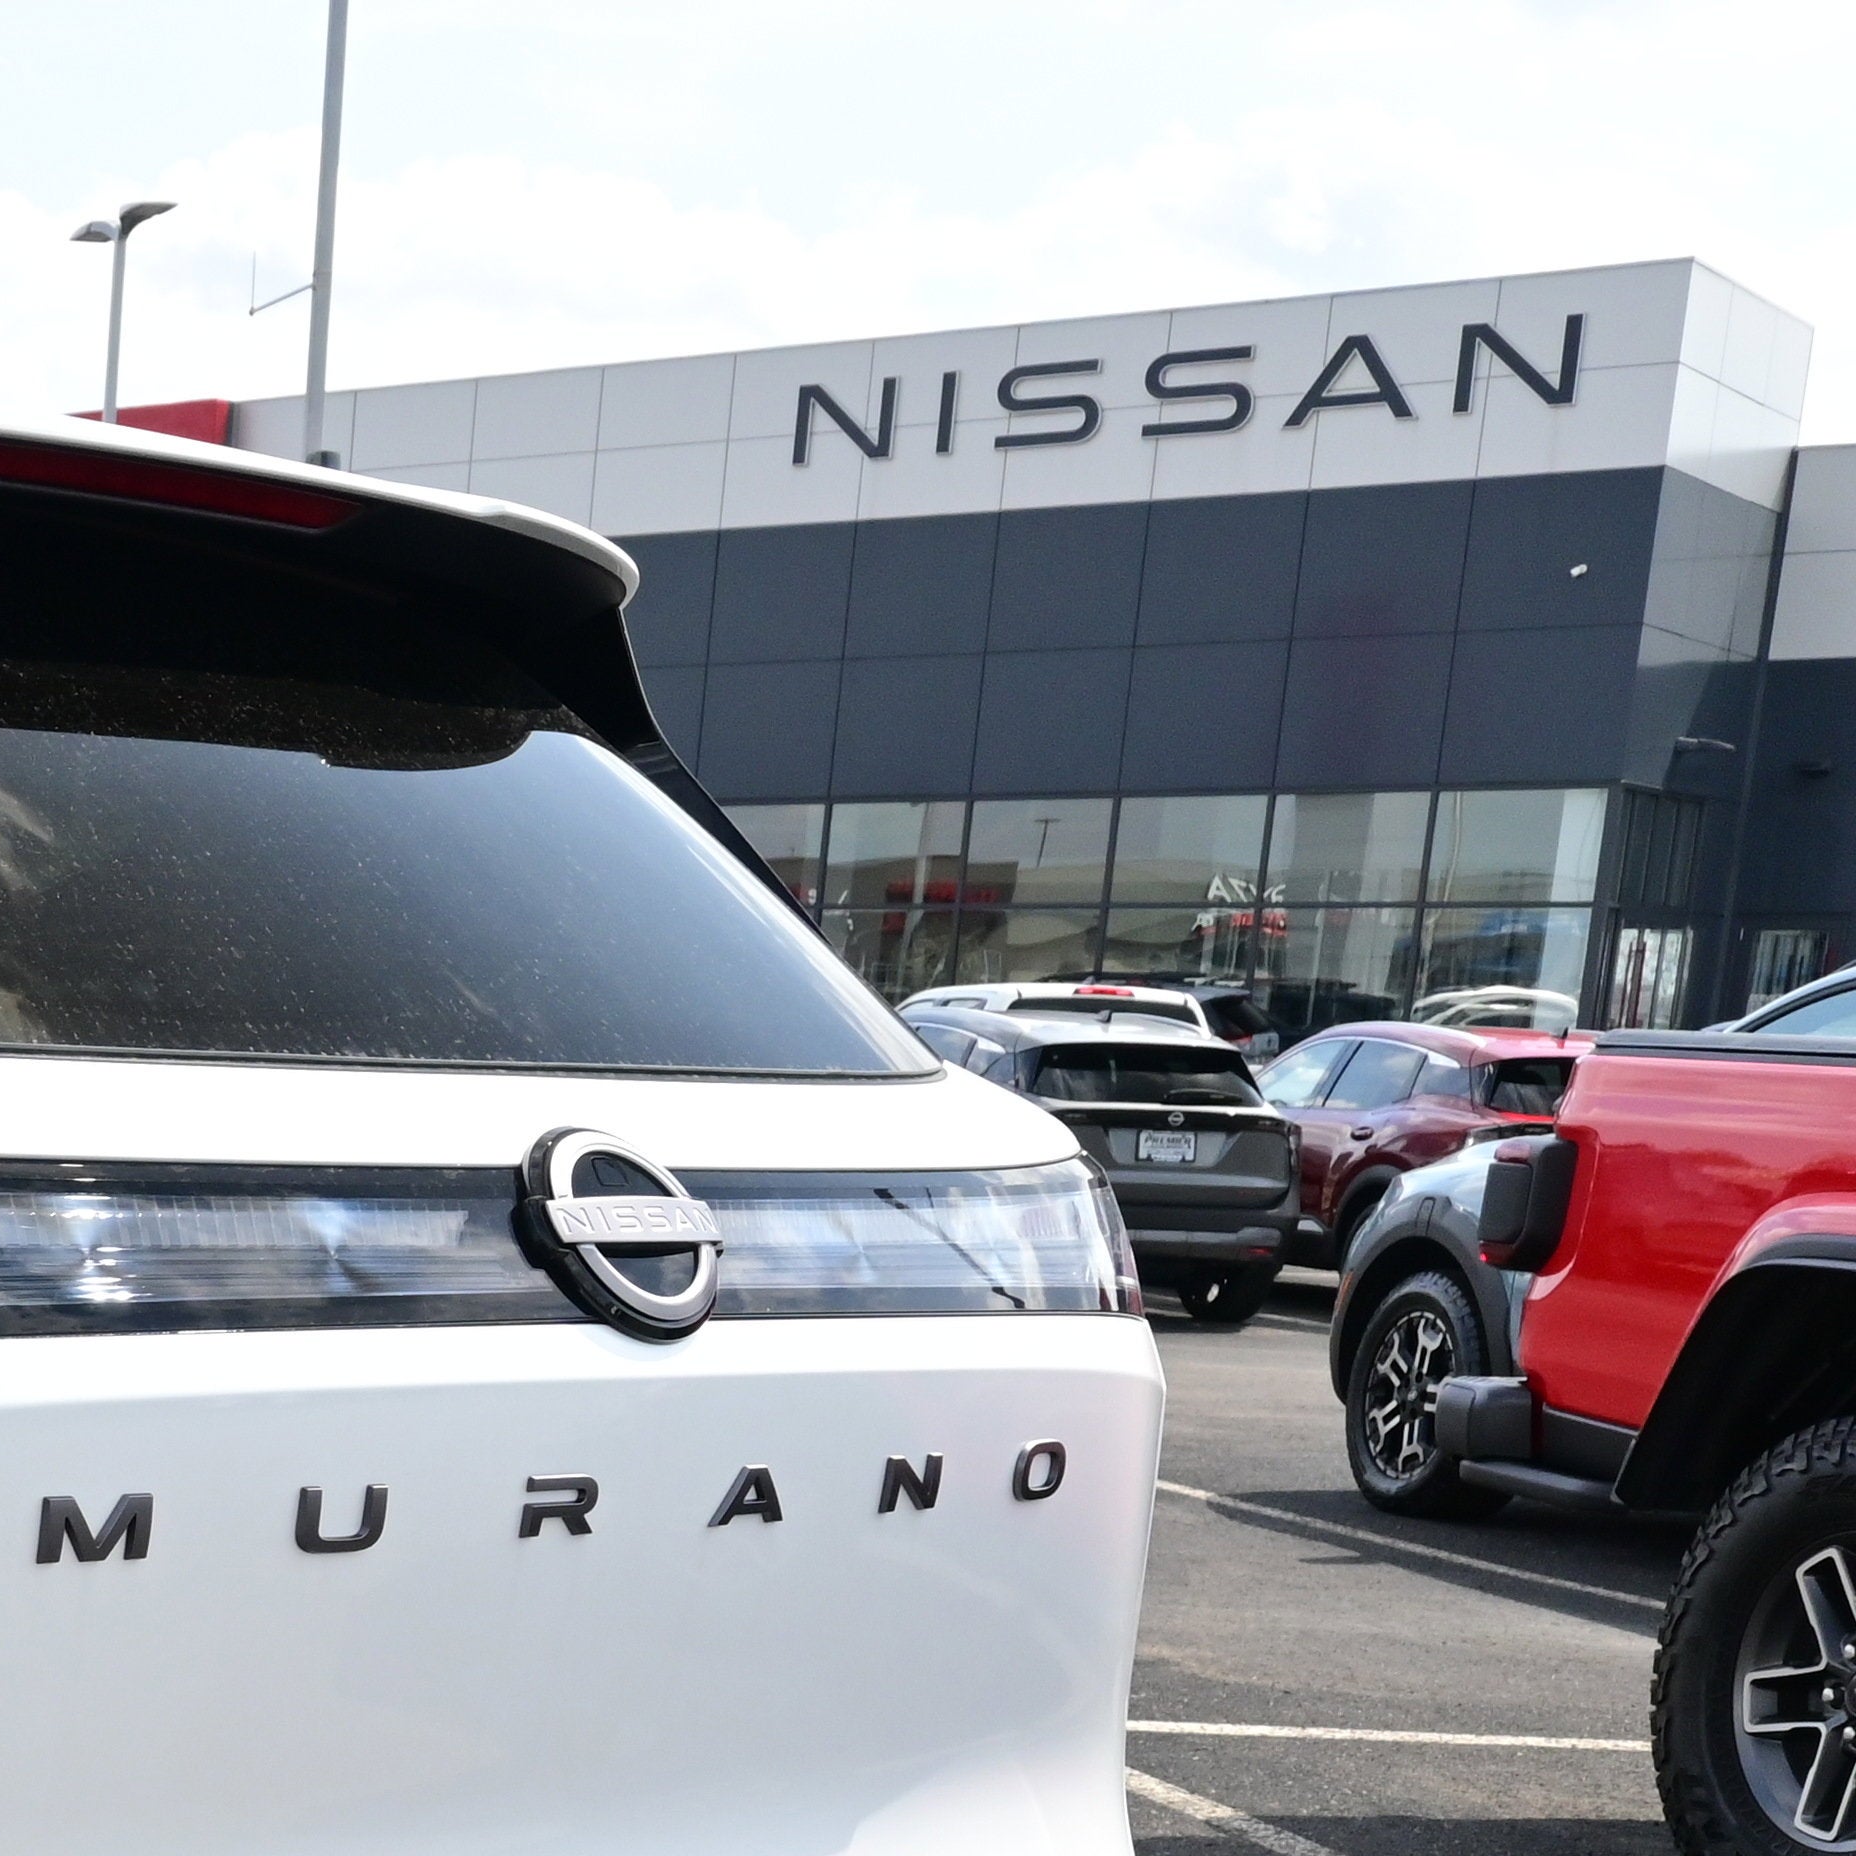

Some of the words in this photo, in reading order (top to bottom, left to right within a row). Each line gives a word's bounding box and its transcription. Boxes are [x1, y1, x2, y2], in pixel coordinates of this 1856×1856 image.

[792, 313, 1585, 467] NISSAN
[556, 1206, 720, 1236] NISSAN
[35, 1438, 1068, 1565] MURANO
